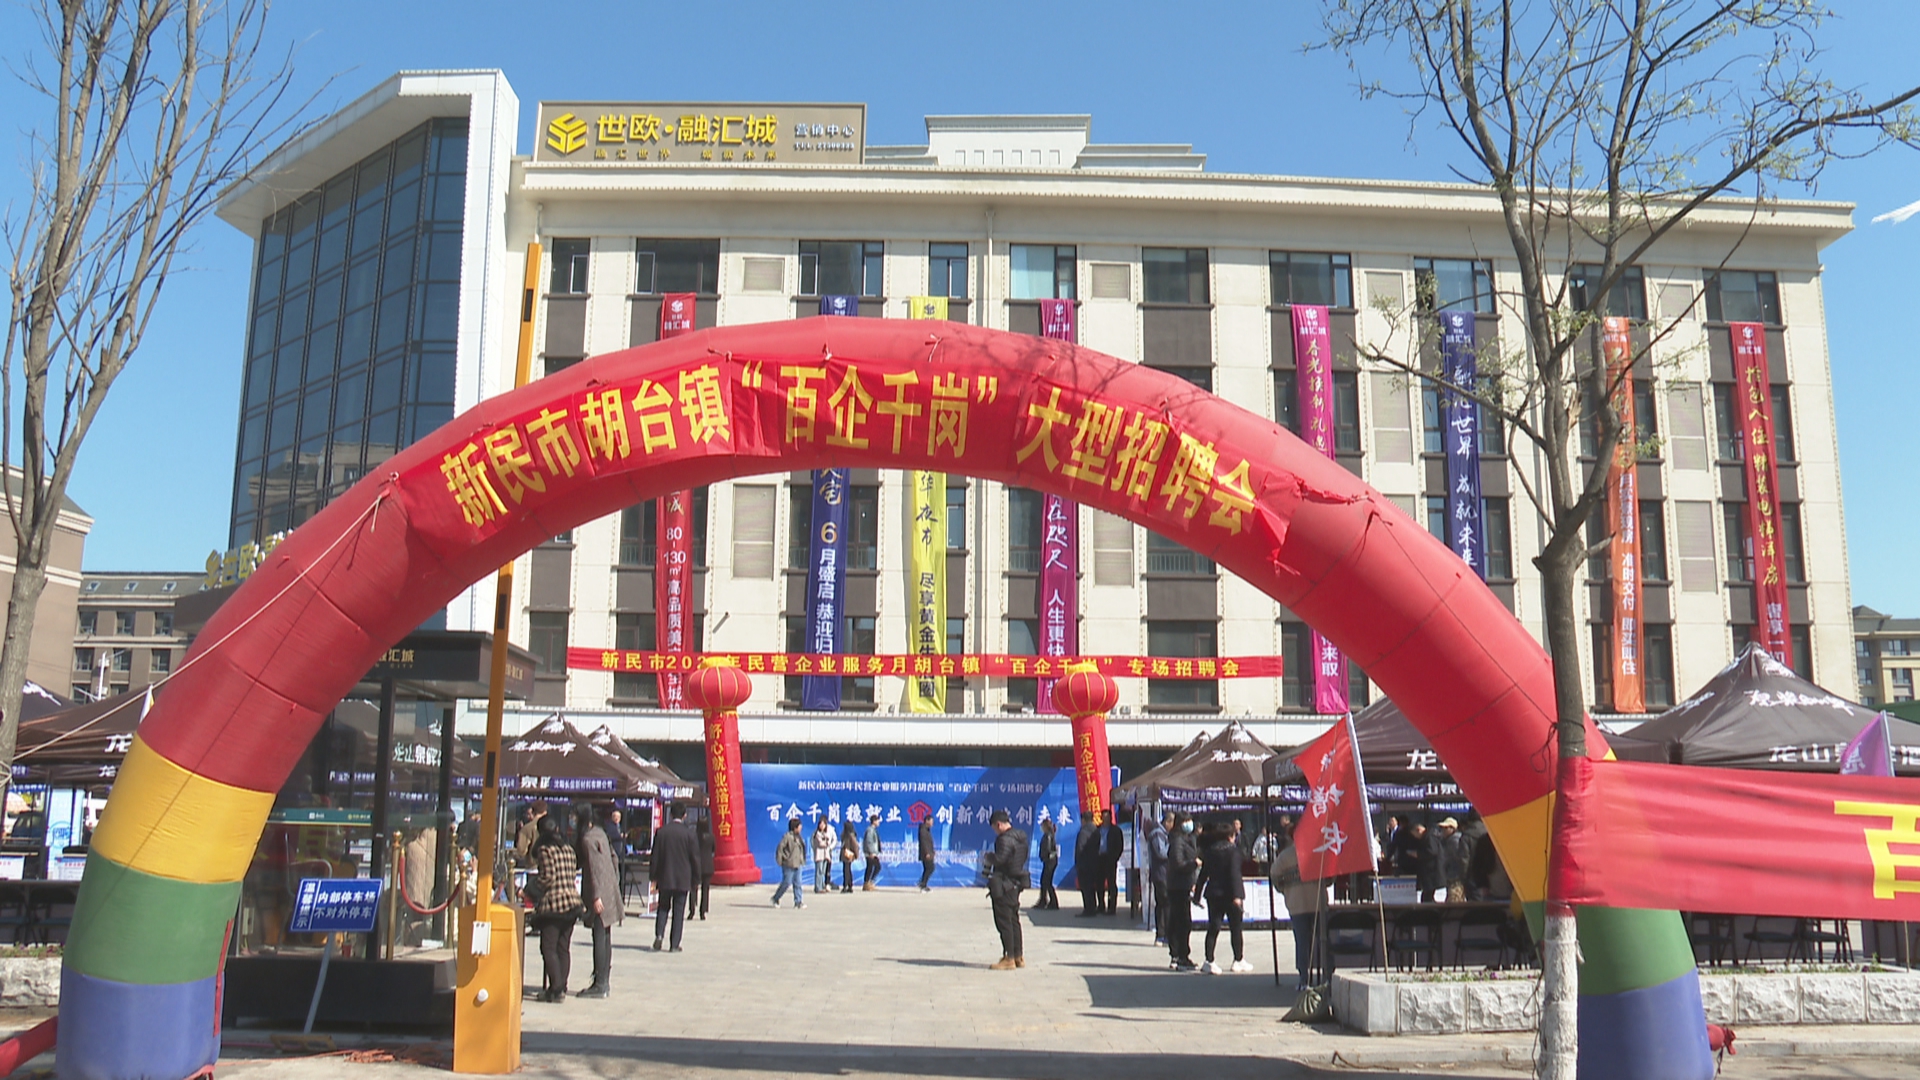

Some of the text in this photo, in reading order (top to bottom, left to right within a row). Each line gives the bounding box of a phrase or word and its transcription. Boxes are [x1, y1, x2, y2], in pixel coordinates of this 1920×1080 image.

[597, 113, 778, 145] 世欧·融汇城
[795, 123, 855, 137] 营销中心
[666, 526, 682, 540] 80
[1046, 494, 1068, 569] 在咫尺
[663, 551, 686, 564] 130
[936, 804, 1074, 826] 创新创创未来
[317, 890, 377, 904] 内部停车场
[296, 882, 316, 928] 温馨提示
[314, 905, 373, 919] 不对外停车
